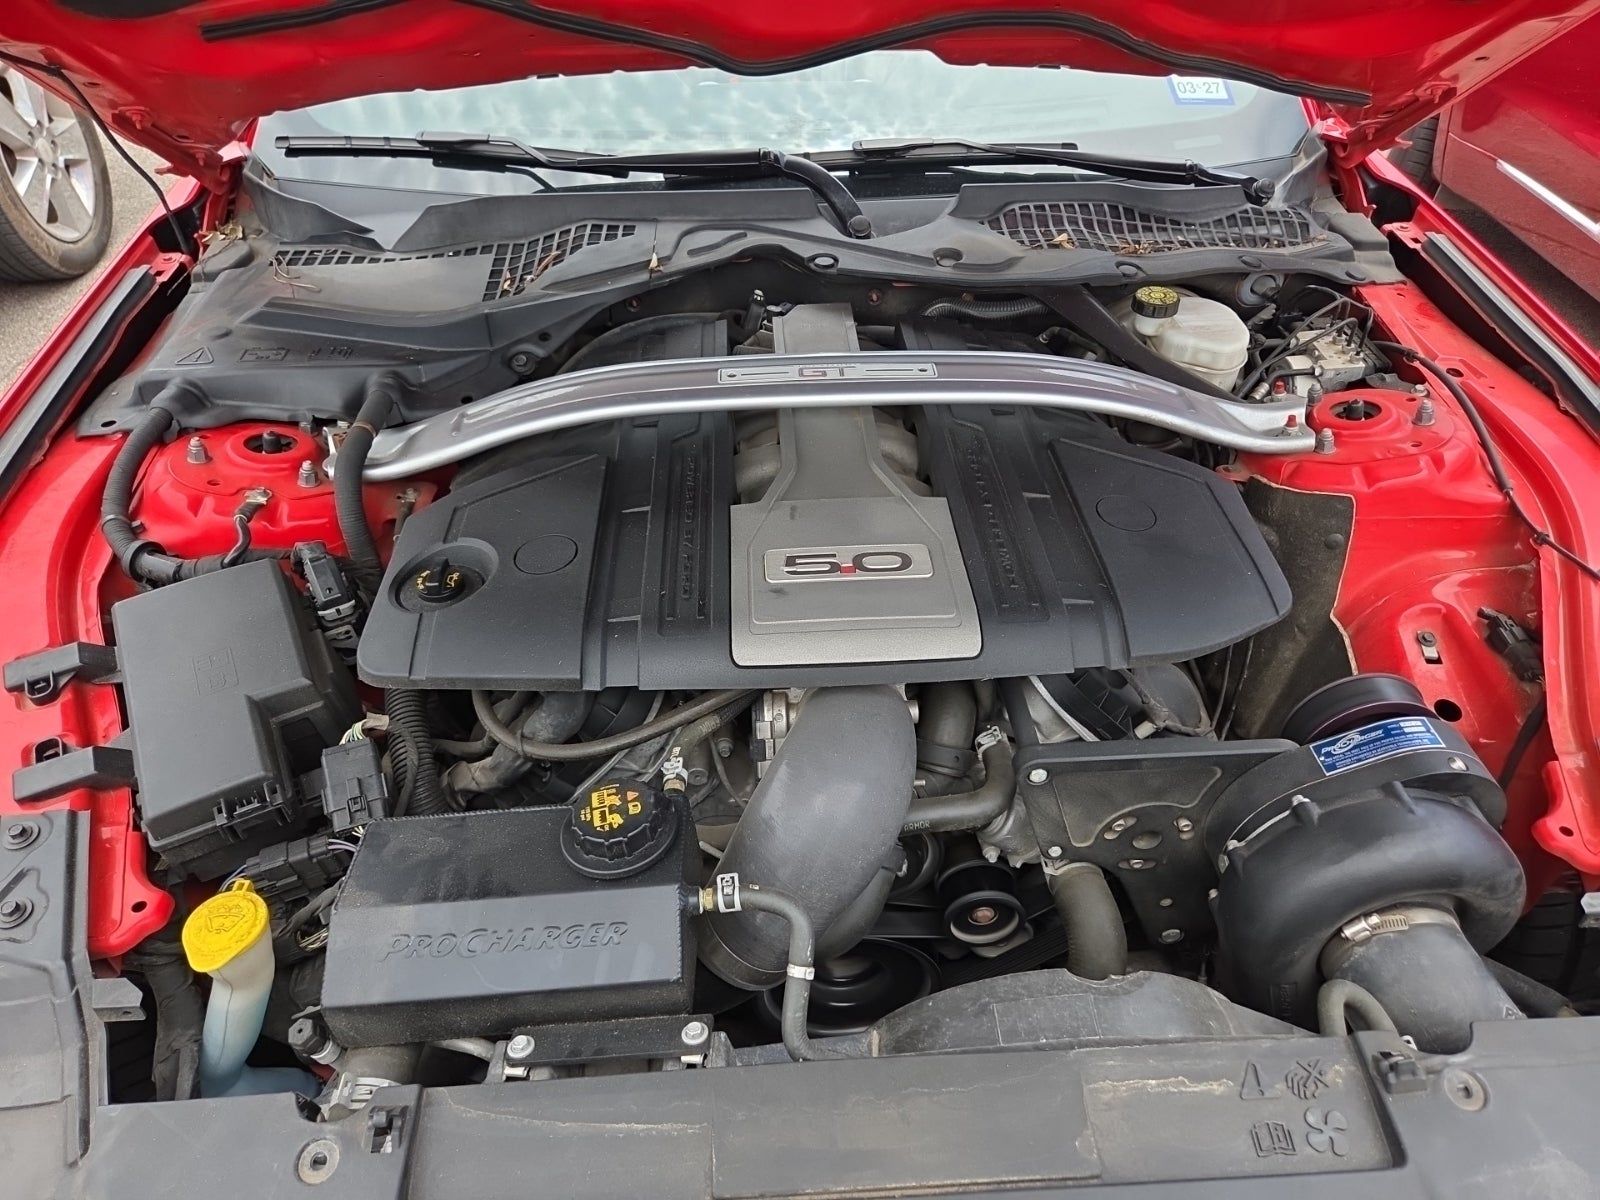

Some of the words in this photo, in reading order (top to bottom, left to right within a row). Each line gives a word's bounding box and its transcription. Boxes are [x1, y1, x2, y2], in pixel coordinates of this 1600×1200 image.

[798, 365, 857, 378] GT
[783, 551, 913, 576] 5.0
[904, 820, 931, 832] ARMOR
[378, 921, 628, 962] PROCHARGER
